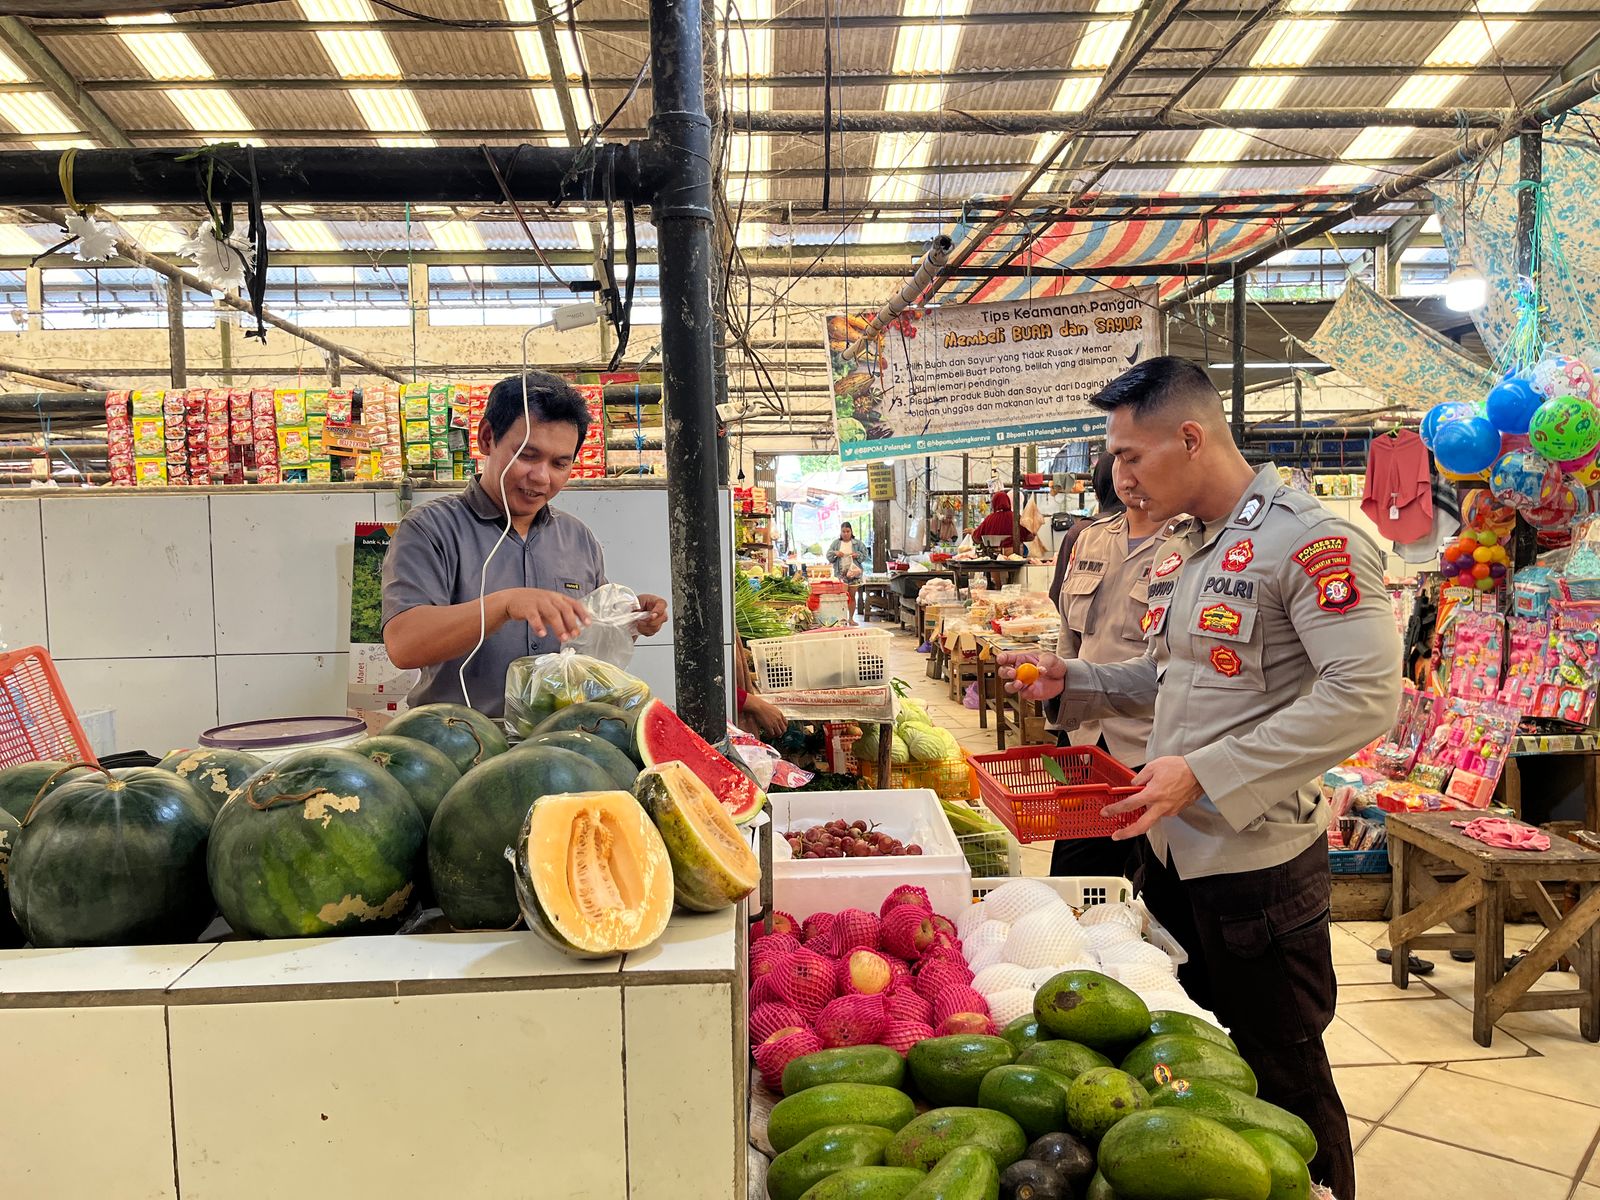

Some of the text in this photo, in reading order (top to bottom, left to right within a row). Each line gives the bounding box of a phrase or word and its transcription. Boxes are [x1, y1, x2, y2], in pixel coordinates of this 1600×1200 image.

[981, 299, 1143, 324] Tips Keamanan Pangan
[943, 315, 1142, 348] Membeli BUAH dan SAYUR
[893, 363, 903, 372] 1.
[925, 360, 946, 369] Buah
[949, 358, 966, 367] dan
[967, 355, 995, 366] Sayur
[997, 353, 1020, 364] yang
[1021, 349, 1045, 359] tidak
[1046, 347, 1073, 357] Rusak
[1075, 347, 1081, 355] /
[1081, 344, 1112, 354] Memar
[894, 375, 904, 384] 2.
[966, 367, 987, 377] Buat
[1025, 361, 1053, 371] belilah
[1054, 360, 1076, 370] yang
[1077, 355, 1118, 367] disimpan
[897, 397, 907, 407] 3.
[950, 391, 981, 403] produk
[983, 389, 1006, 399] Buah
[1007, 387, 1024, 396] dan
[1025, 385, 1052, 395] Sayur
[1054, 382, 1073, 391] dari
[1074, 379, 1105, 390] Daging
[908, 377, 1010, 394] dalam lemari pendingin
[942, 404, 974, 416] unggas
[976, 402, 993, 411] dan
[994, 398, 1034, 409] makanan
[1035, 396, 1053, 405] laut
[1055, 395, 1064, 403] di
[1065, 393, 1081, 402] tas
[1034, 427, 1062, 436] Palangka
[1298, 538, 1342, 560] POLRESTA
[1203, 576, 1254, 600] POLRI
[357, 662, 365, 684] Maret
